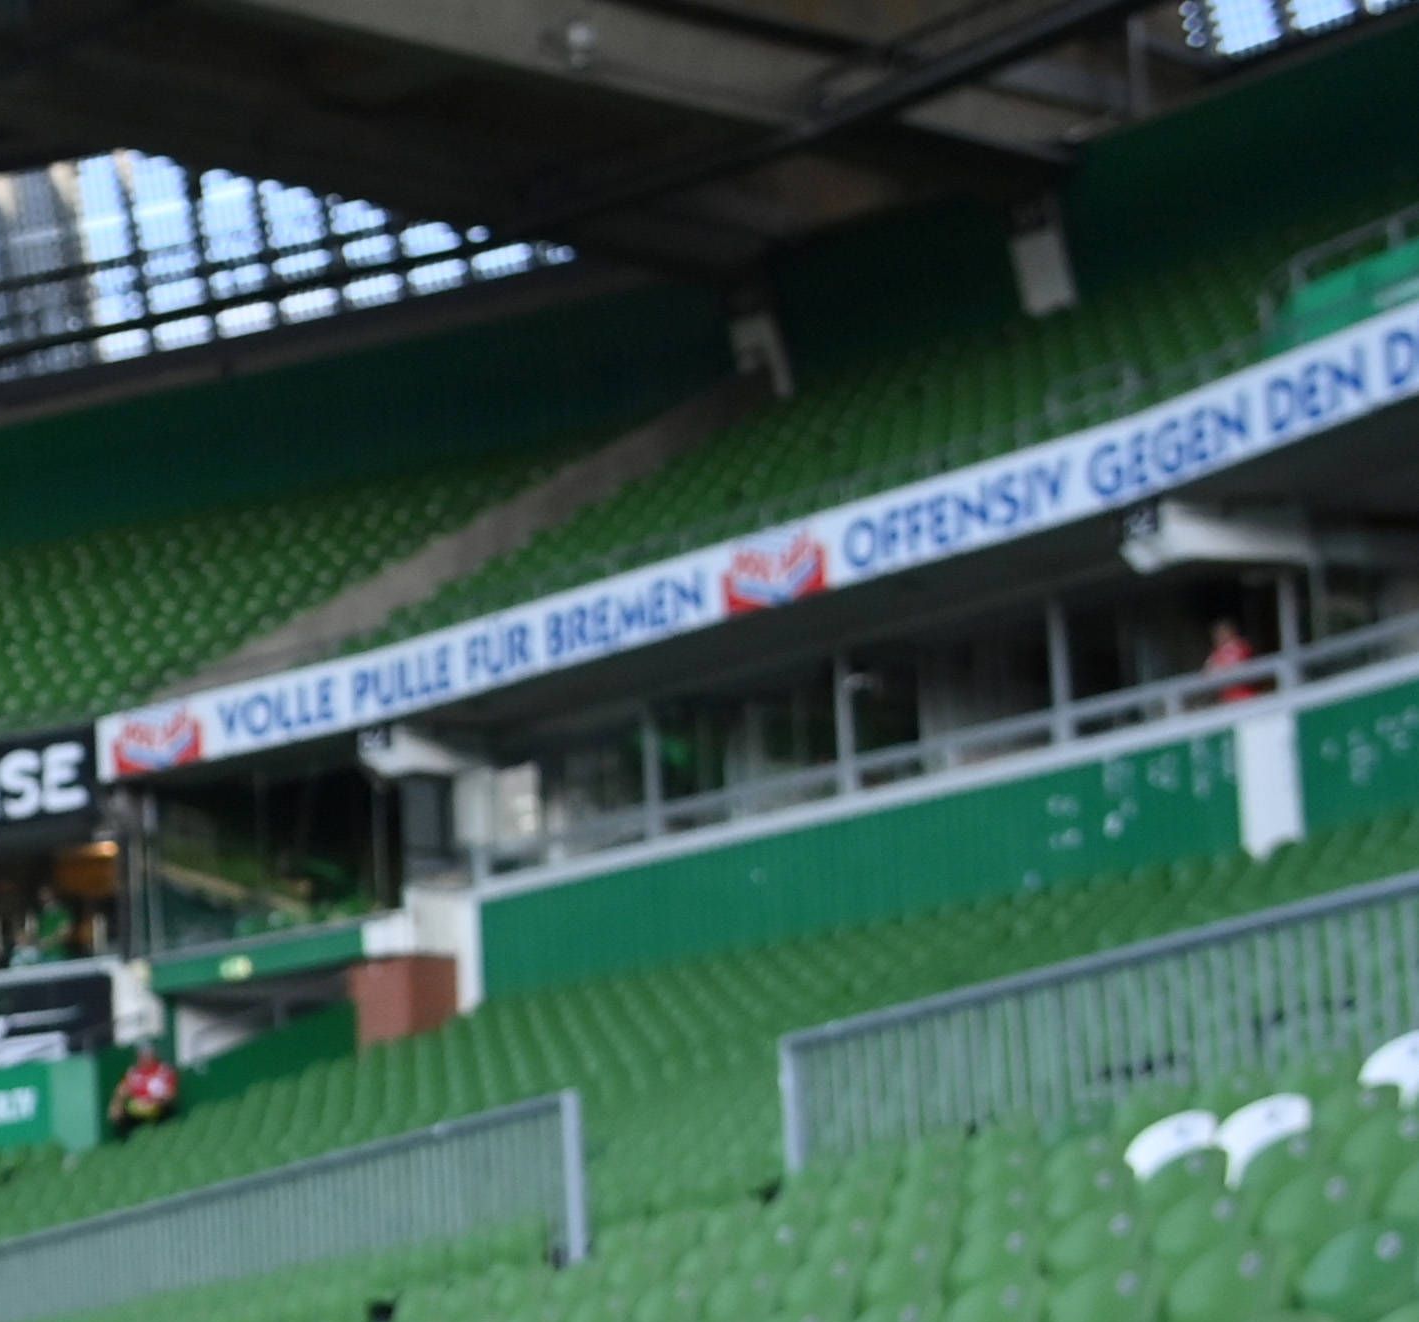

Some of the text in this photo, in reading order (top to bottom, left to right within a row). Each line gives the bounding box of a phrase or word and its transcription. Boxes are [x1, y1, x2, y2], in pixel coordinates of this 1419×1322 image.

[842, 462, 1065, 569] OFFENSIV
[1085, 398, 1248, 497] GEGEN
[1266, 347, 1364, 434] DEN
[220, 679, 334, 739] VOLLE
[352, 645, 453, 714] PULLE
[546, 578, 703, 655] BREMEN
